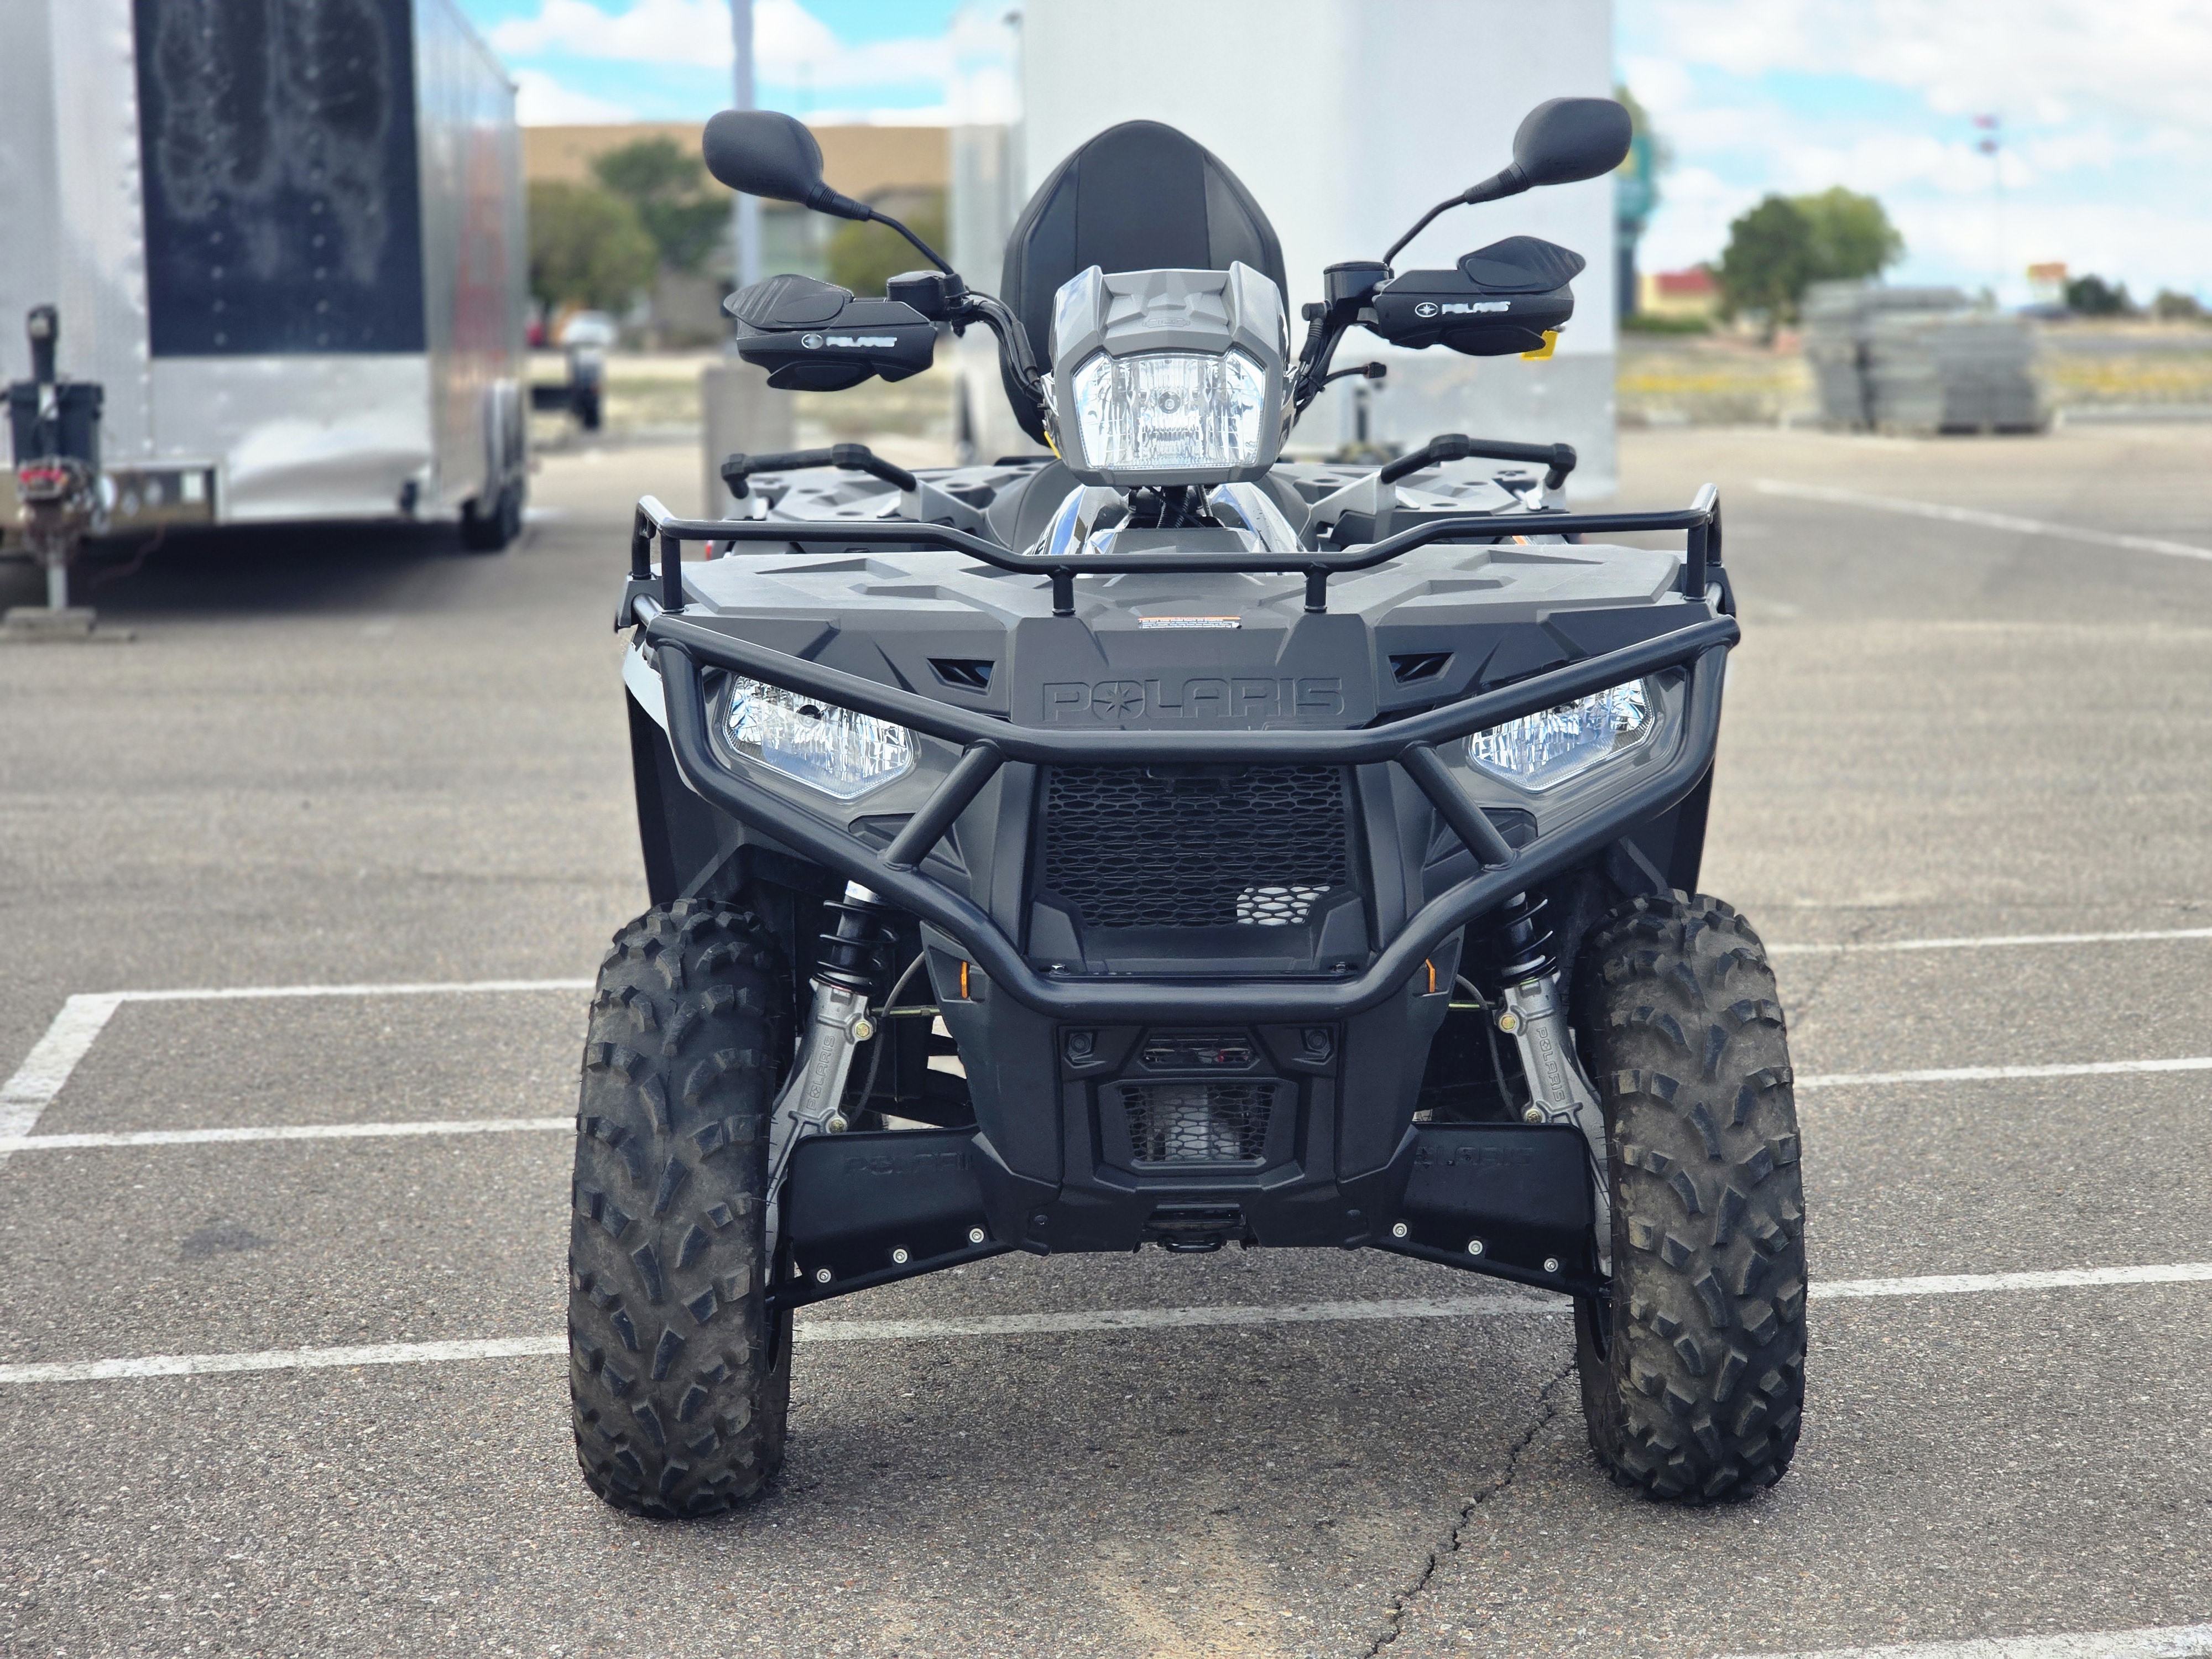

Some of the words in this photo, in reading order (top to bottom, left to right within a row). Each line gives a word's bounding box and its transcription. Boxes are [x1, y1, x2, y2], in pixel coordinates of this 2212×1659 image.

[1042, 677, 1345, 721] POLARIS
[806, 1035, 836, 1111] POLARIS
[1536, 1026, 1565, 1102] POLARIS
